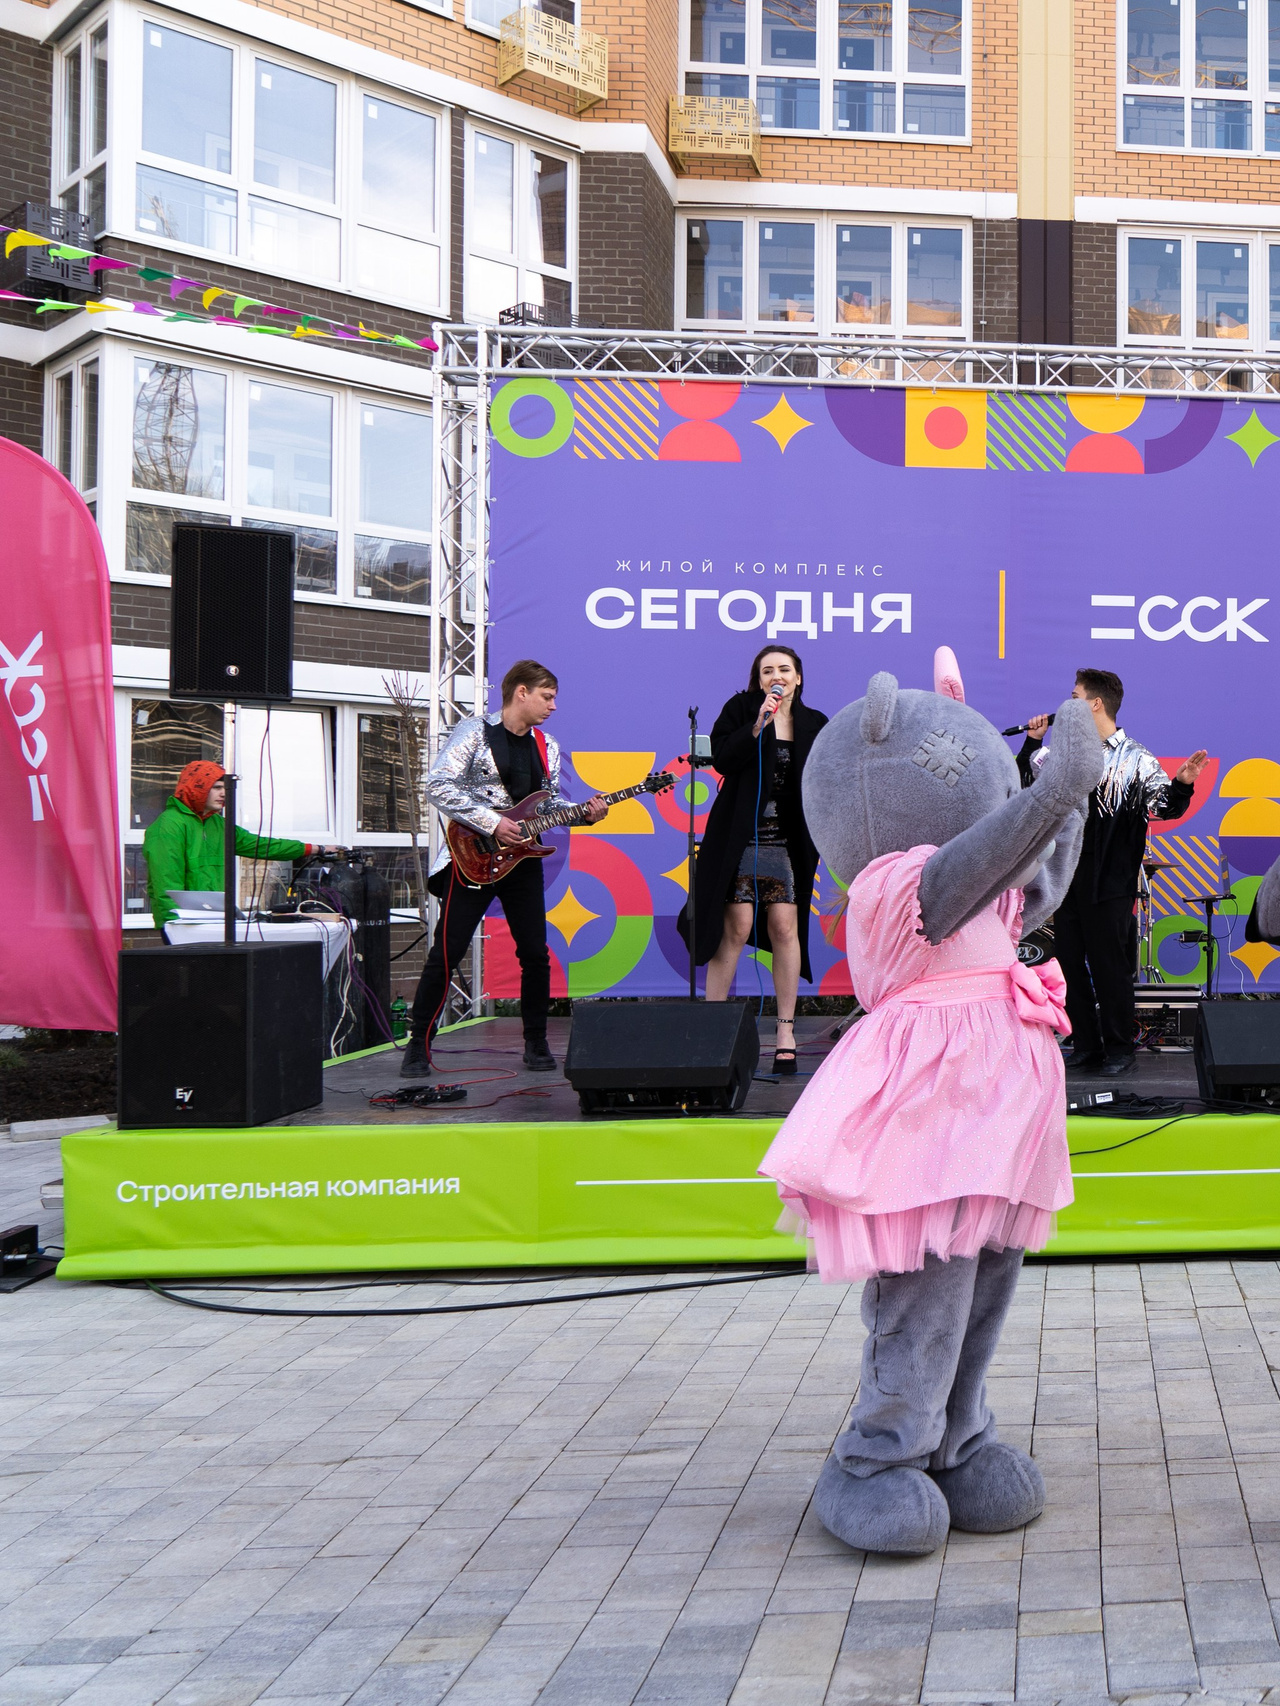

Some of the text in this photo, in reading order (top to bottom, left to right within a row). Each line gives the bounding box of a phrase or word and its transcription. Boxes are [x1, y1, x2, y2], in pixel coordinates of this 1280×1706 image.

[616, 559, 884, 577] ЖИЛОЙ КОМПЛЕКС
[585, 587, 913, 639] СЕГОДНЯ
[116, 1177, 460, 1208] Строительная компания
